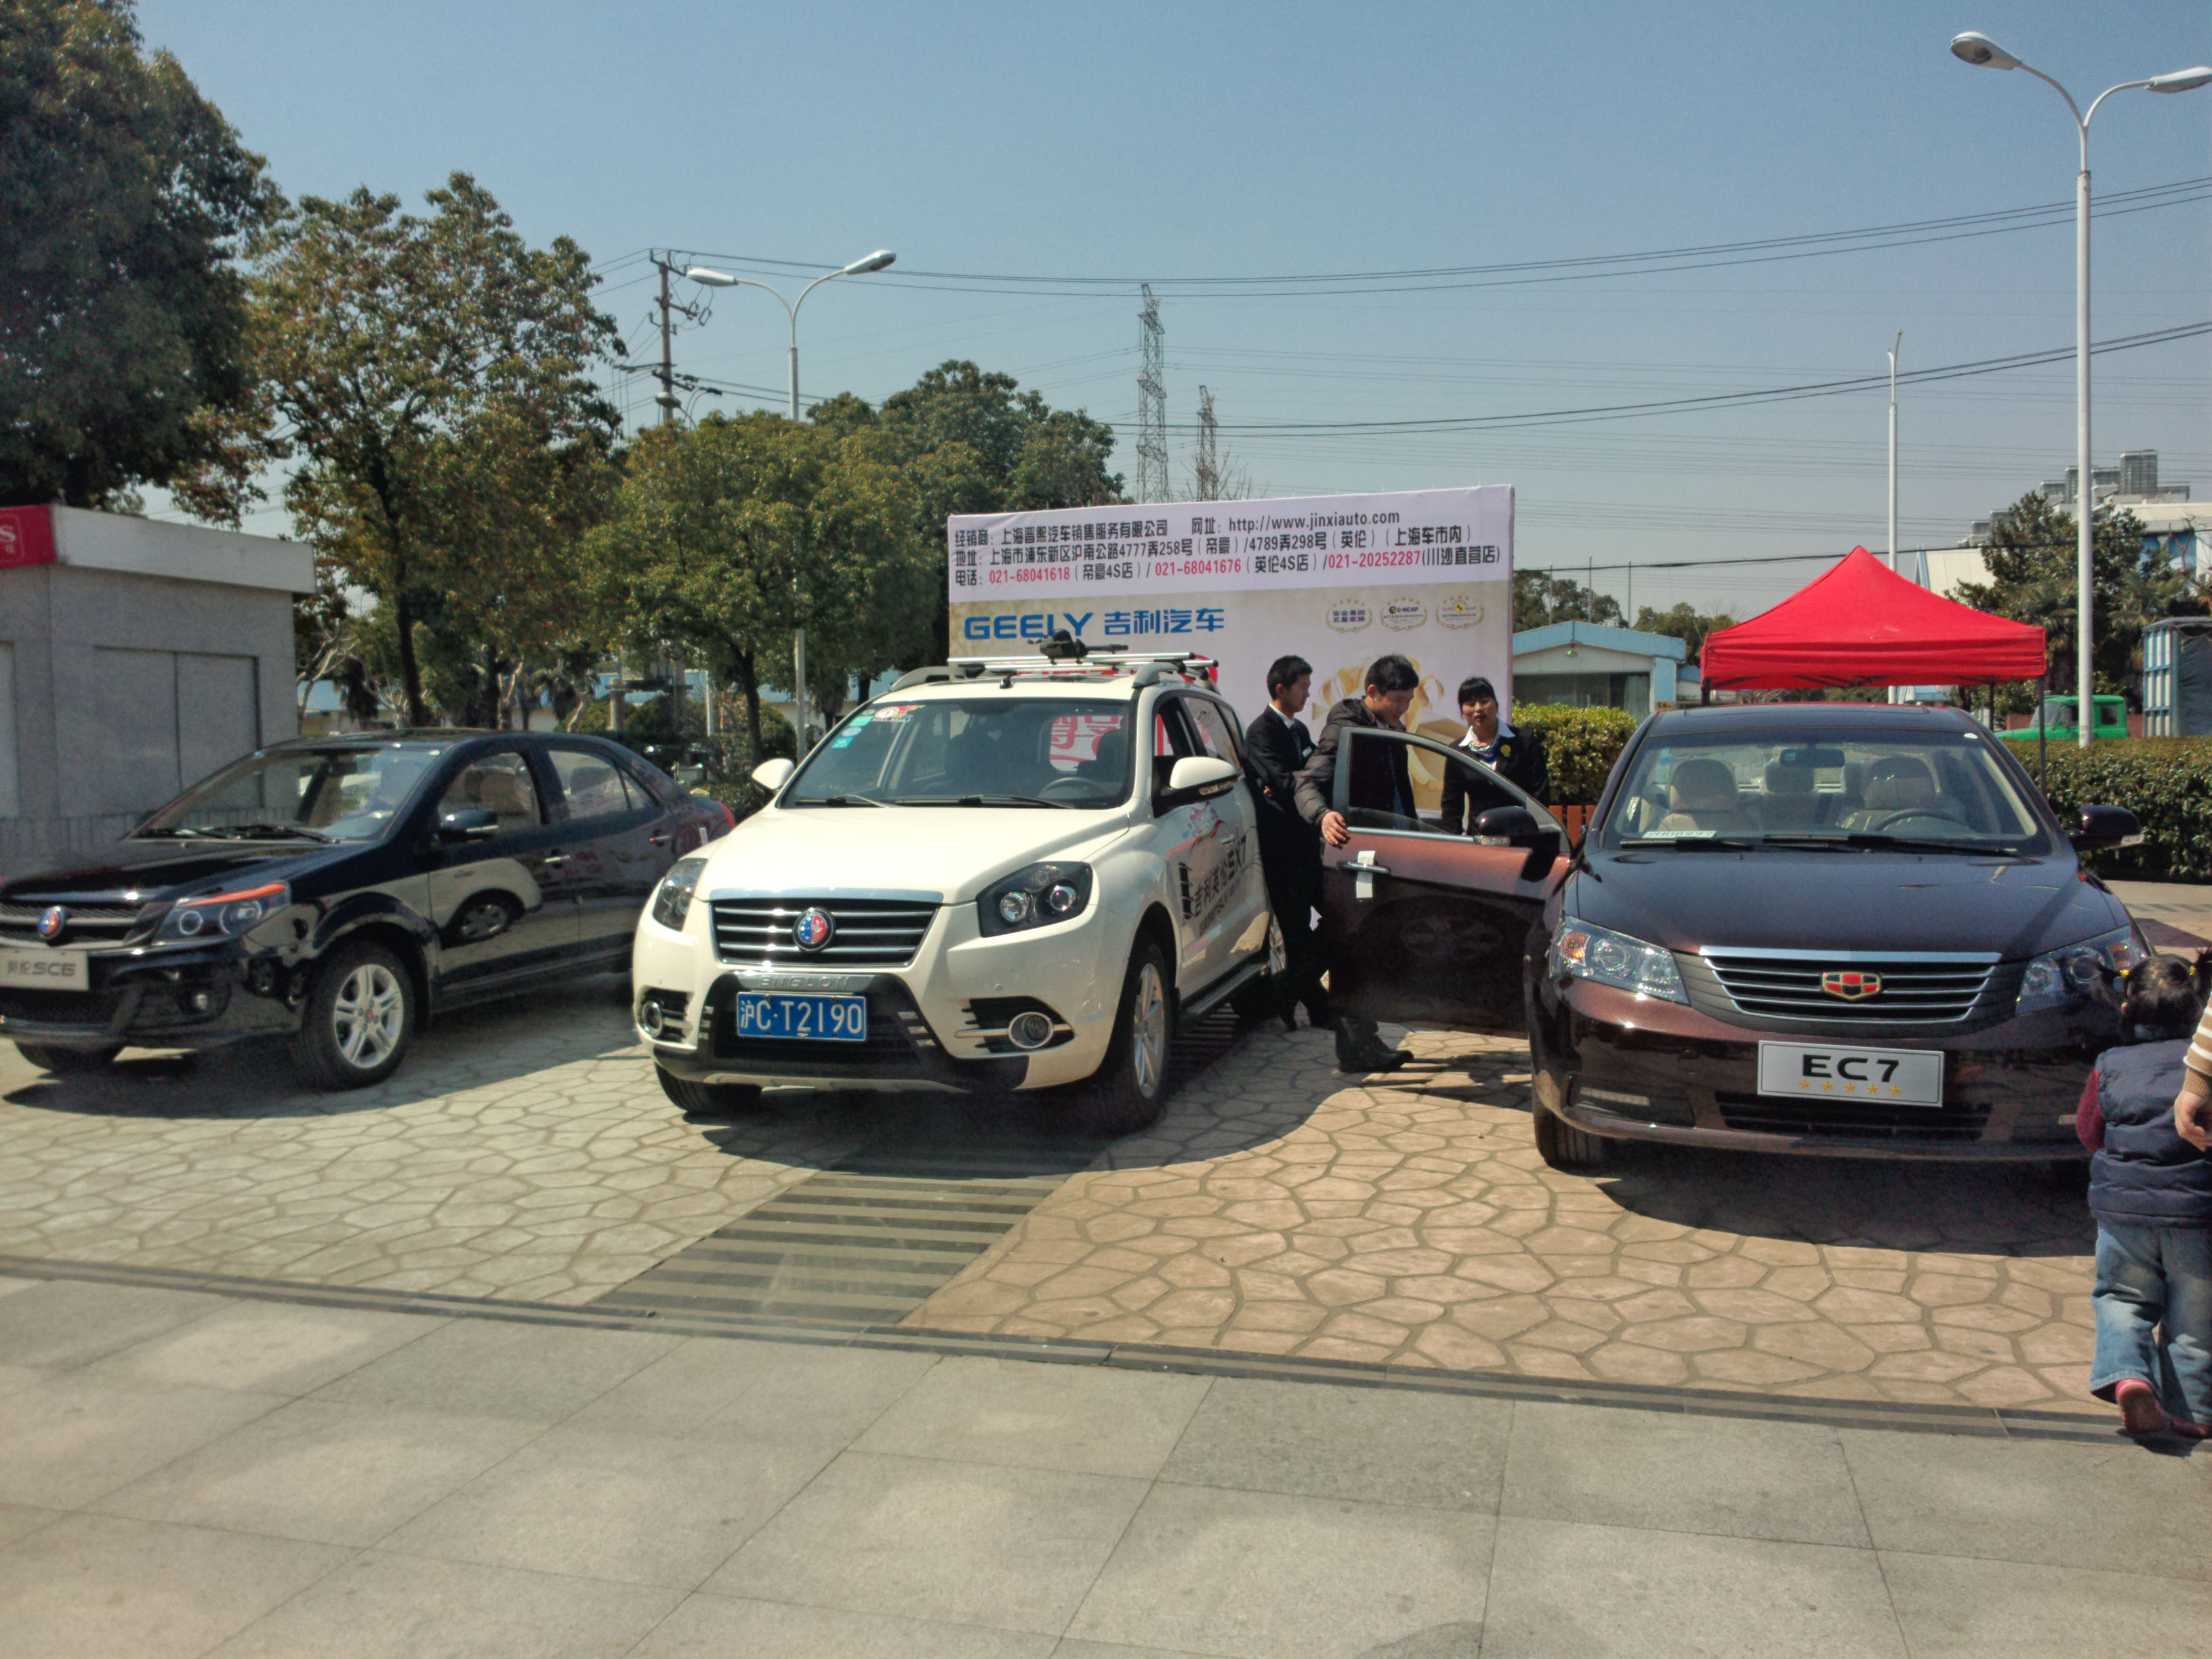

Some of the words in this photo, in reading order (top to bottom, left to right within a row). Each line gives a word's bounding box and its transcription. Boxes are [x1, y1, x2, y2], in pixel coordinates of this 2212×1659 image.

[964, 612, 1094, 640] GEELY
[1104, 608, 1225, 635] 吉利汽车
[1802, 1054, 1900, 1083] EC7
